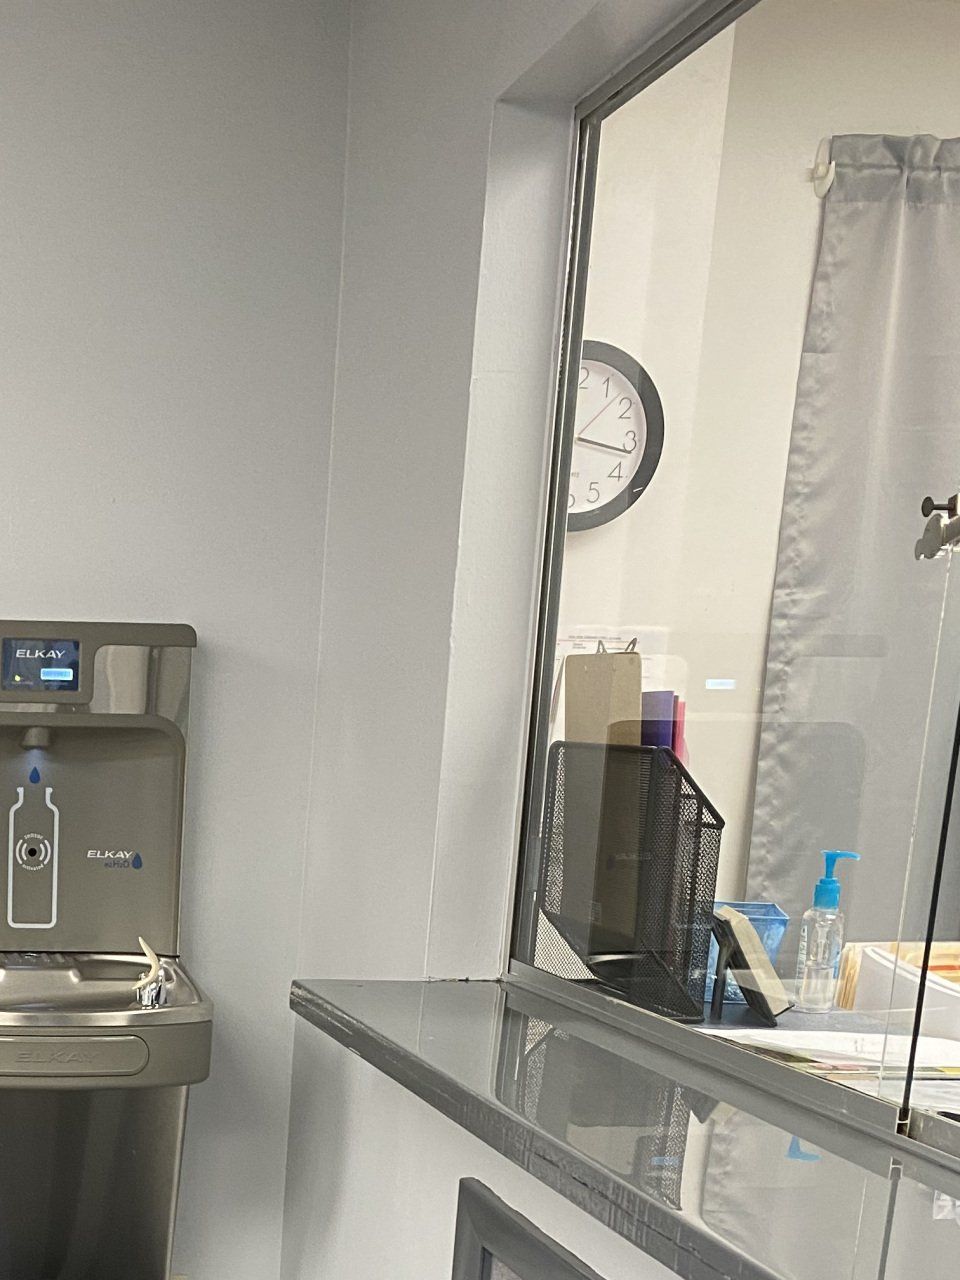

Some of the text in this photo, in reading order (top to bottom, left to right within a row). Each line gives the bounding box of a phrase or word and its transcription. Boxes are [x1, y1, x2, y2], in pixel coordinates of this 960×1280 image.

[601, 376, 611, 398] 1
[617, 396, 633, 420] 2
[622, 430, 637, 453] 3
[607, 460, 623, 482] 4
[586, 481, 601, 504] 5
[15, 648, 66, 659] ELKAY
[86, 849, 133, 859] ELKAY
[14, 1050, 97, 1064] ELKAY
